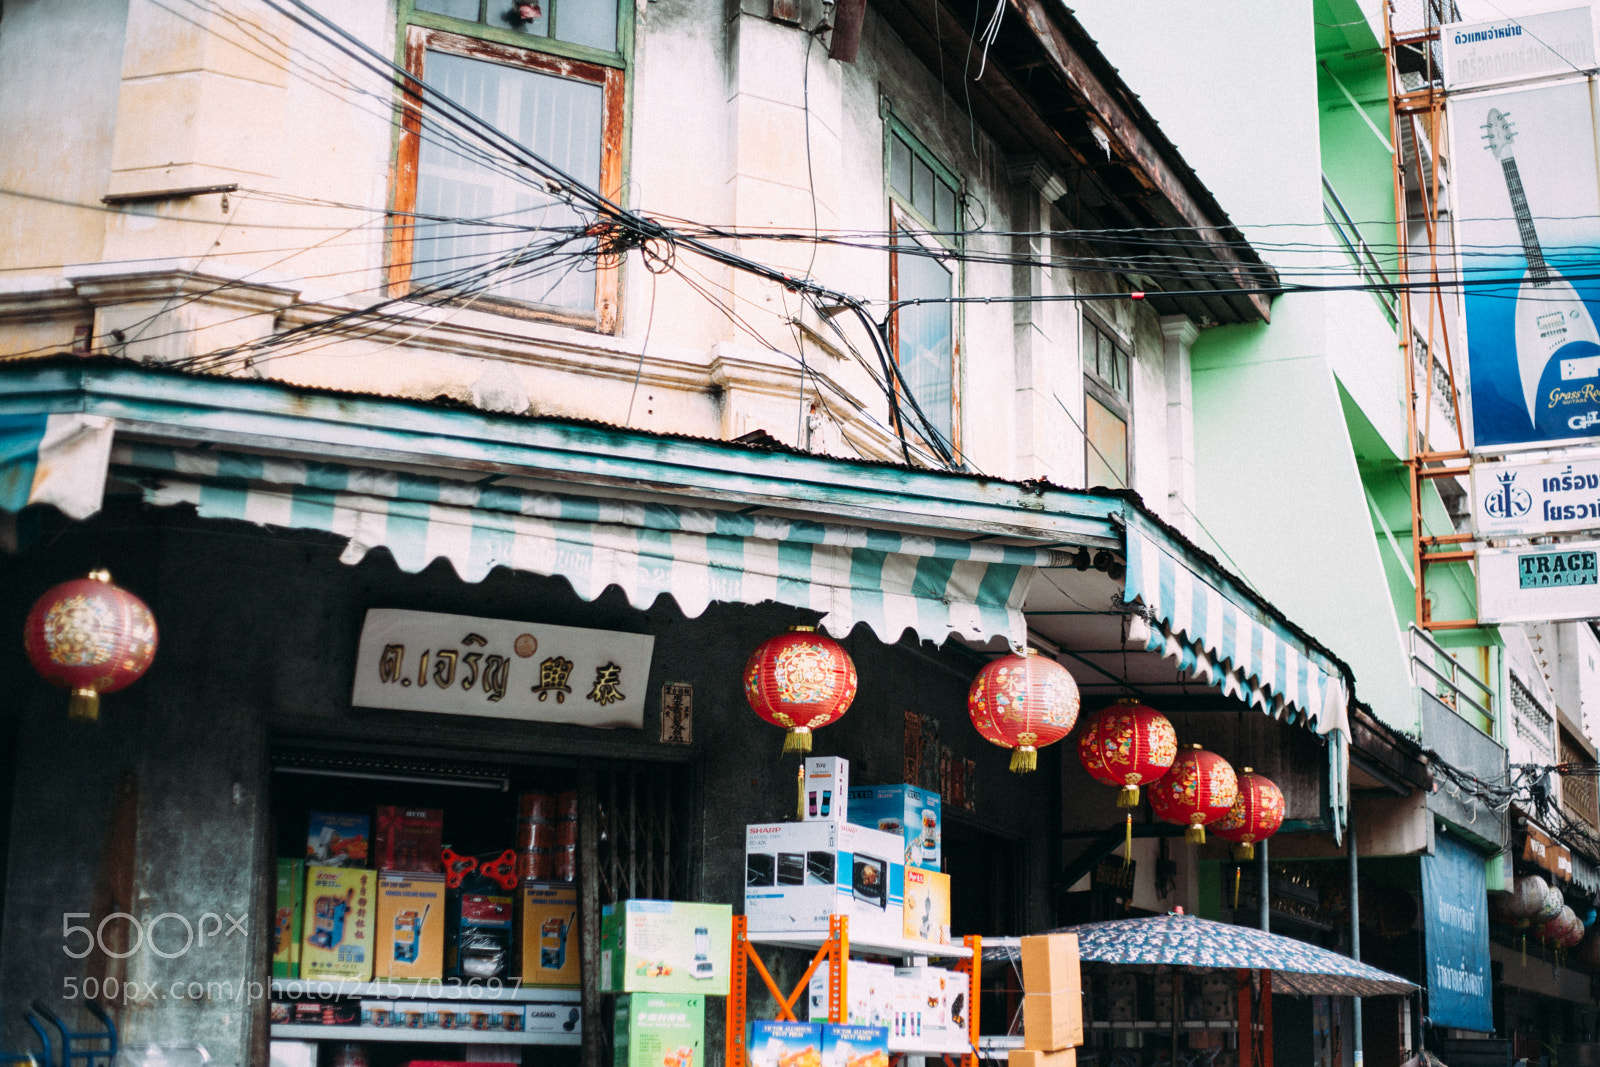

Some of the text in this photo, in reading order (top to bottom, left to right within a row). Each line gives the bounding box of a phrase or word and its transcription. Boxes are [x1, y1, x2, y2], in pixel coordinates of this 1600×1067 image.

[1455, 24, 1522, 45] ตัวแทนจำหน่าย
[1548, 387, 1581, 408] Grass
[1543, 465, 1600, 493] เครื่อง
[1521, 553, 1595, 574] TRACE
[379, 632, 510, 702] ต.เจริญ
[749, 826, 782, 834] SHARP
[840, 824, 858, 834] SHARP
